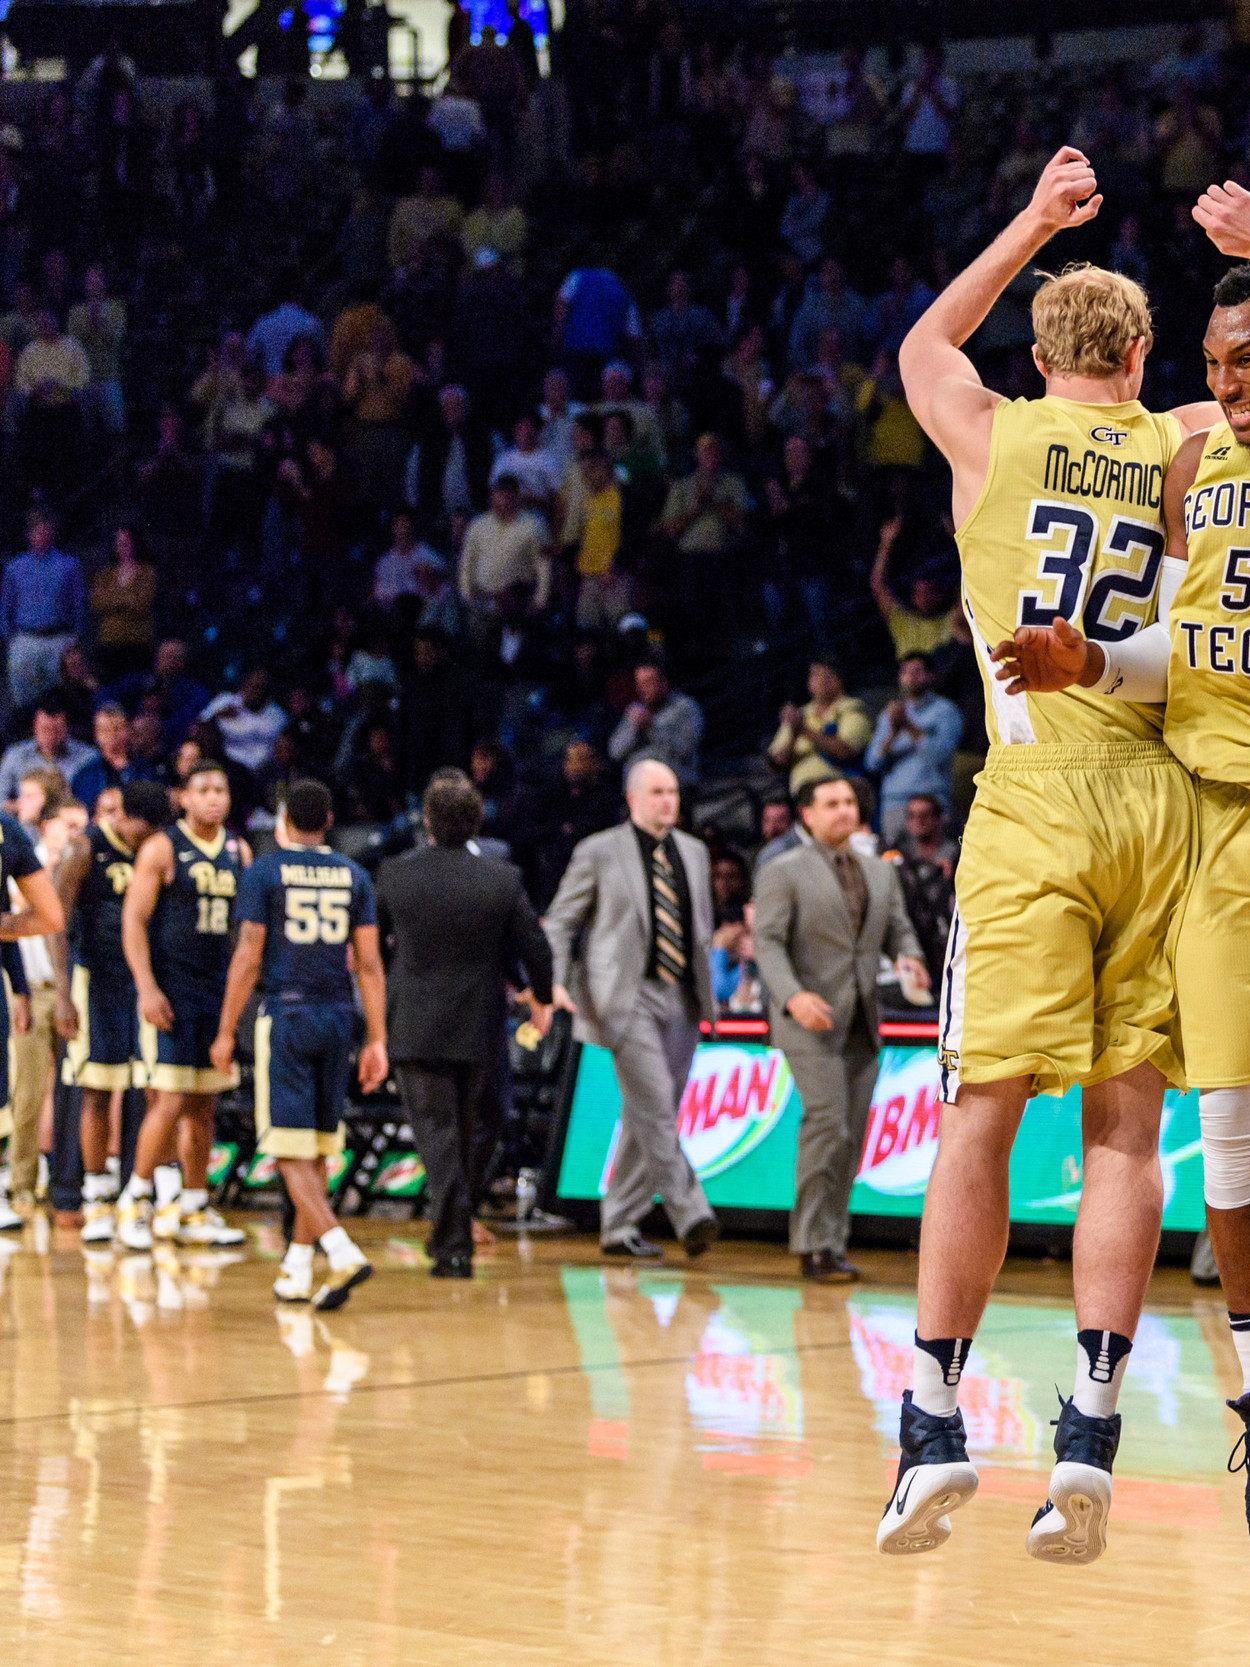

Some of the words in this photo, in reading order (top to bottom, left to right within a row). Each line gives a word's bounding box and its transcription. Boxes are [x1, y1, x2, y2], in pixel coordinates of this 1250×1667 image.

[1090, 427, 1128, 446] GT
[1016, 498, 1166, 643] 32
[280, 863, 353, 886] MILLIGAN
[195, 898, 229, 934] 12
[284, 888, 350, 944] 55
